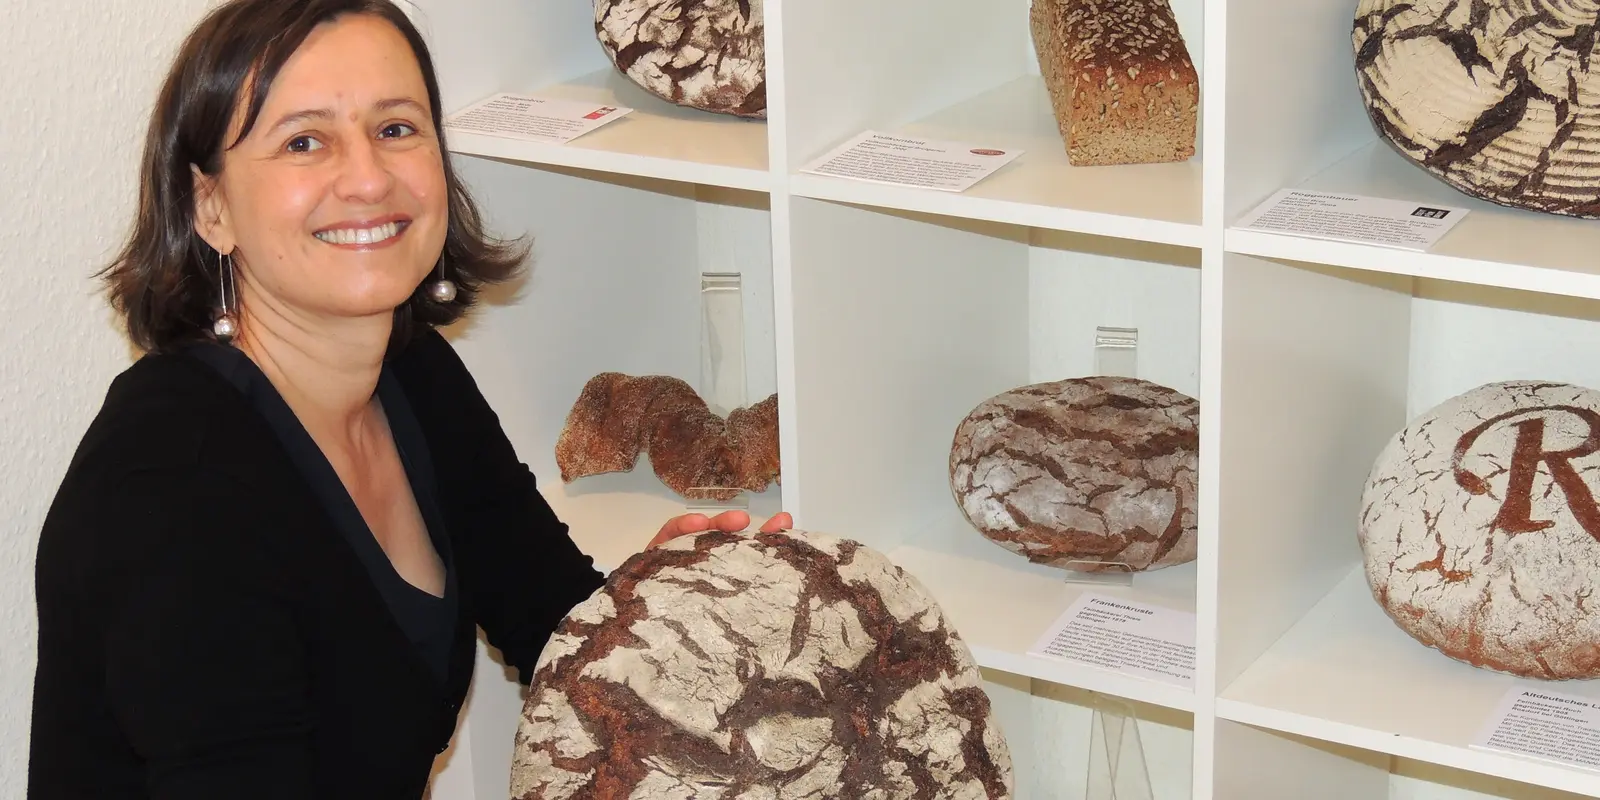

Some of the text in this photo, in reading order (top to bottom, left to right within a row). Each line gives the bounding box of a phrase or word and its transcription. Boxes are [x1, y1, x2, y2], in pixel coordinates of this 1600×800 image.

[873, 135, 925, 145] Vollkornbrot
[1291, 192, 1358, 202] Roggenbauer
[1451, 404, 1600, 543] R
[1083, 606, 1122, 617] Feinbäckerei
[1090, 598, 1154, 615] Frankenkruste
[1076, 614, 1105, 623] Göttingen
[1079, 611, 1111, 620] gegründet
[1066, 624, 1105, 637] Unternehmen
[1122, 632, 1162, 644] Generationen
[1050, 641, 1088, 653] Engagement
[1058, 632, 1090, 643] Backwaren
[1160, 654, 1182, 662] Region
[1139, 645, 1162, 653] Kunden
[1517, 699, 1562, 710] Feinbäckerei
[1521, 691, 1588, 707] Altdeutsches
[1514, 703, 1550, 712] gegründet
[1511, 706, 1541, 715] Rosdorf
[1553, 714, 1589, 724] Göttingen
[1520, 715, 1561, 727] Kombination
